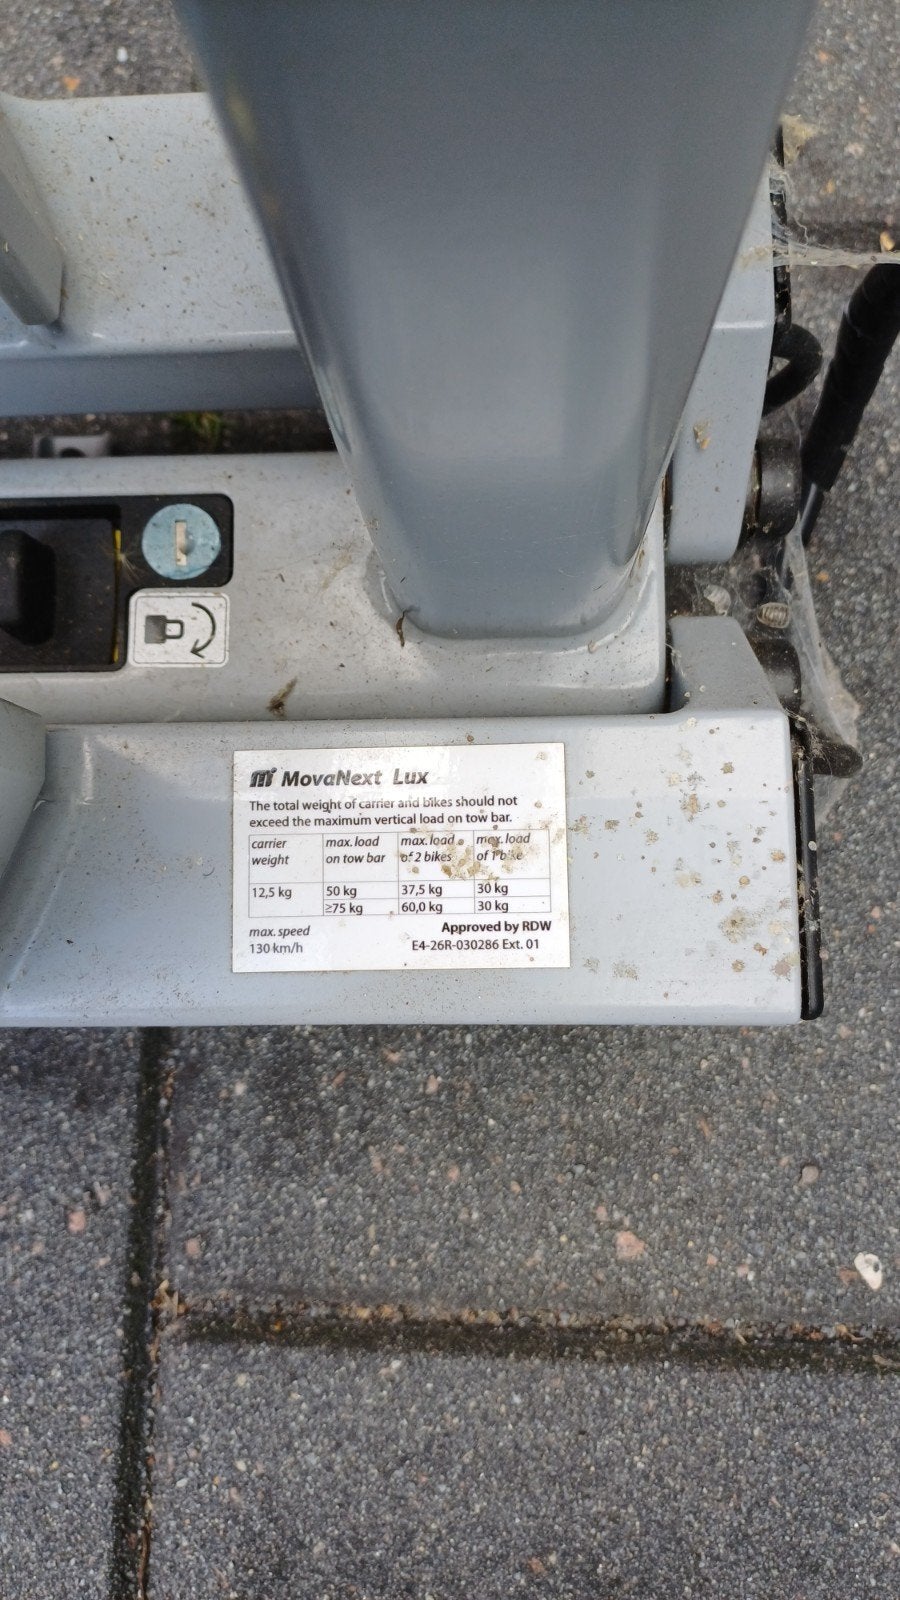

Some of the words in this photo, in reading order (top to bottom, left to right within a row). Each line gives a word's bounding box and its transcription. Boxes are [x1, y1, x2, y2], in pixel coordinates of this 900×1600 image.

[281, 769, 382, 787] MovaNext
[393, 768, 429, 784] Lux
[250, 801, 270, 811] The
[274, 801, 299, 810] total
[302, 800, 341, 812] weight
[345, 799, 357, 809] of
[359, 799, 394, 808] carrier
[398, 797, 419, 808] and
[423, 797, 452, 807] bikes
[456, 795, 494, 806] should
[498, 796, 518, 805] not
[250, 817, 289, 827] exceed
[293, 816, 310, 826] the
[314, 816, 371, 826] maximum
[375, 814, 416, 825] vertical
[420, 813, 444, 823] load
[448, 815, 462, 823] on
[466, 814, 487, 822] tow
[491, 812, 512, 822] bar.
[252, 838, 287, 848] carrier
[252, 853, 289, 867] weight
[326, 855, 340, 863] on
[343, 854, 364, 863] tow
[367, 852, 386, 862] bar
[415, 852, 421, 862] 2
[425, 851, 452, 861] bikes
[477, 850, 489, 860] of
[493, 851, 497, 860] 1
[501, 850, 523, 860] bke
[252, 887, 275, 898] 12,5
[278, 887, 292, 899] kg
[326, 886, 340, 896] 50
[344, 886, 357, 898] kg
[402, 885, 425, 896] 37,5
[429, 884, 442, 896] kg
[478, 883, 491, 893] 30
[495, 883, 508, 895] kg
[350, 903, 363, 915] kg
[401, 902, 426, 913] 60,0
[429, 902, 443, 913] kg
[478, 901, 491, 911] 30
[495, 900, 508, 913] kg
[442, 922, 502, 935] Approved
[505, 922, 519, 933] by
[522, 921, 552, 931] RDW
[250, 944, 270, 953] 130
[273, 942, 303, 953] km/h
[412, 940, 499, 950] E4-26R-030286
[503, 939, 523, 949] Ext.
[526, 939, 539, 949] 01
